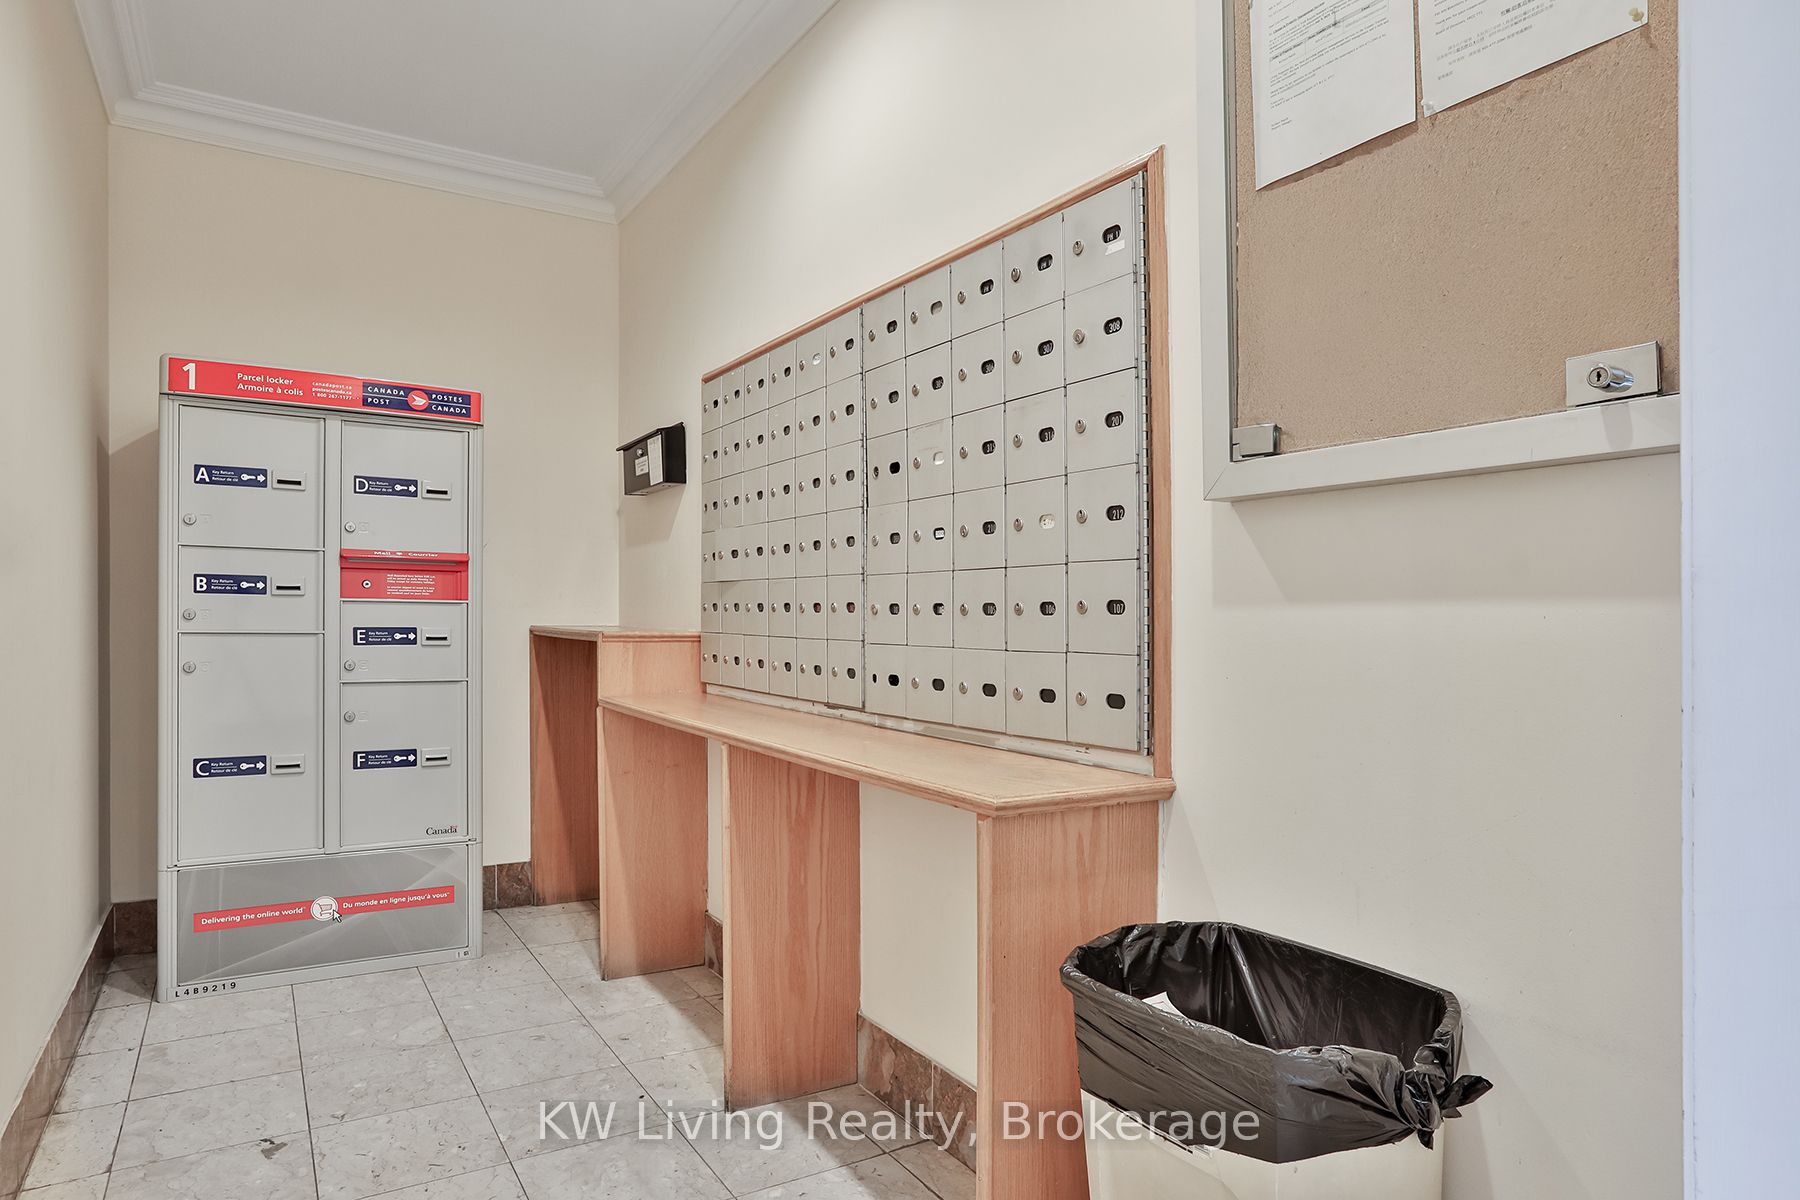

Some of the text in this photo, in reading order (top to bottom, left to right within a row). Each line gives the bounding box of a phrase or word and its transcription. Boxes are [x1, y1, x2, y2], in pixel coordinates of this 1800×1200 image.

[1108, 320, 1120, 333] 308
[182, 362, 196, 390] 1
[237, 372, 294, 385] Parcel locker
[237, 383, 304, 396] Armoire à colis
[367, 386, 405, 396] CANADA
[367, 397, 390, 405] POST
[431, 393, 463, 403] POSTES
[431, 405, 467, 414] CANADA
[1111, 414, 1122, 427] 201
[195, 467, 210, 482] A
[355, 478, 369, 492] D
[1112, 508, 1124, 520] 212
[196, 576, 207, 591] B
[1112, 603, 1124, 614] 107
[357, 629, 366, 644] E
[357, 753, 366, 767] F
[196, 761, 210, 776] C
[425, 826, 457, 836] Canada
[354, 899, 378, 907] monde
[389, 896, 406, 905] ligne
[201, 914, 241, 925] Delivering
[242, 912, 255, 920] the
[256, 909, 280, 918] online
